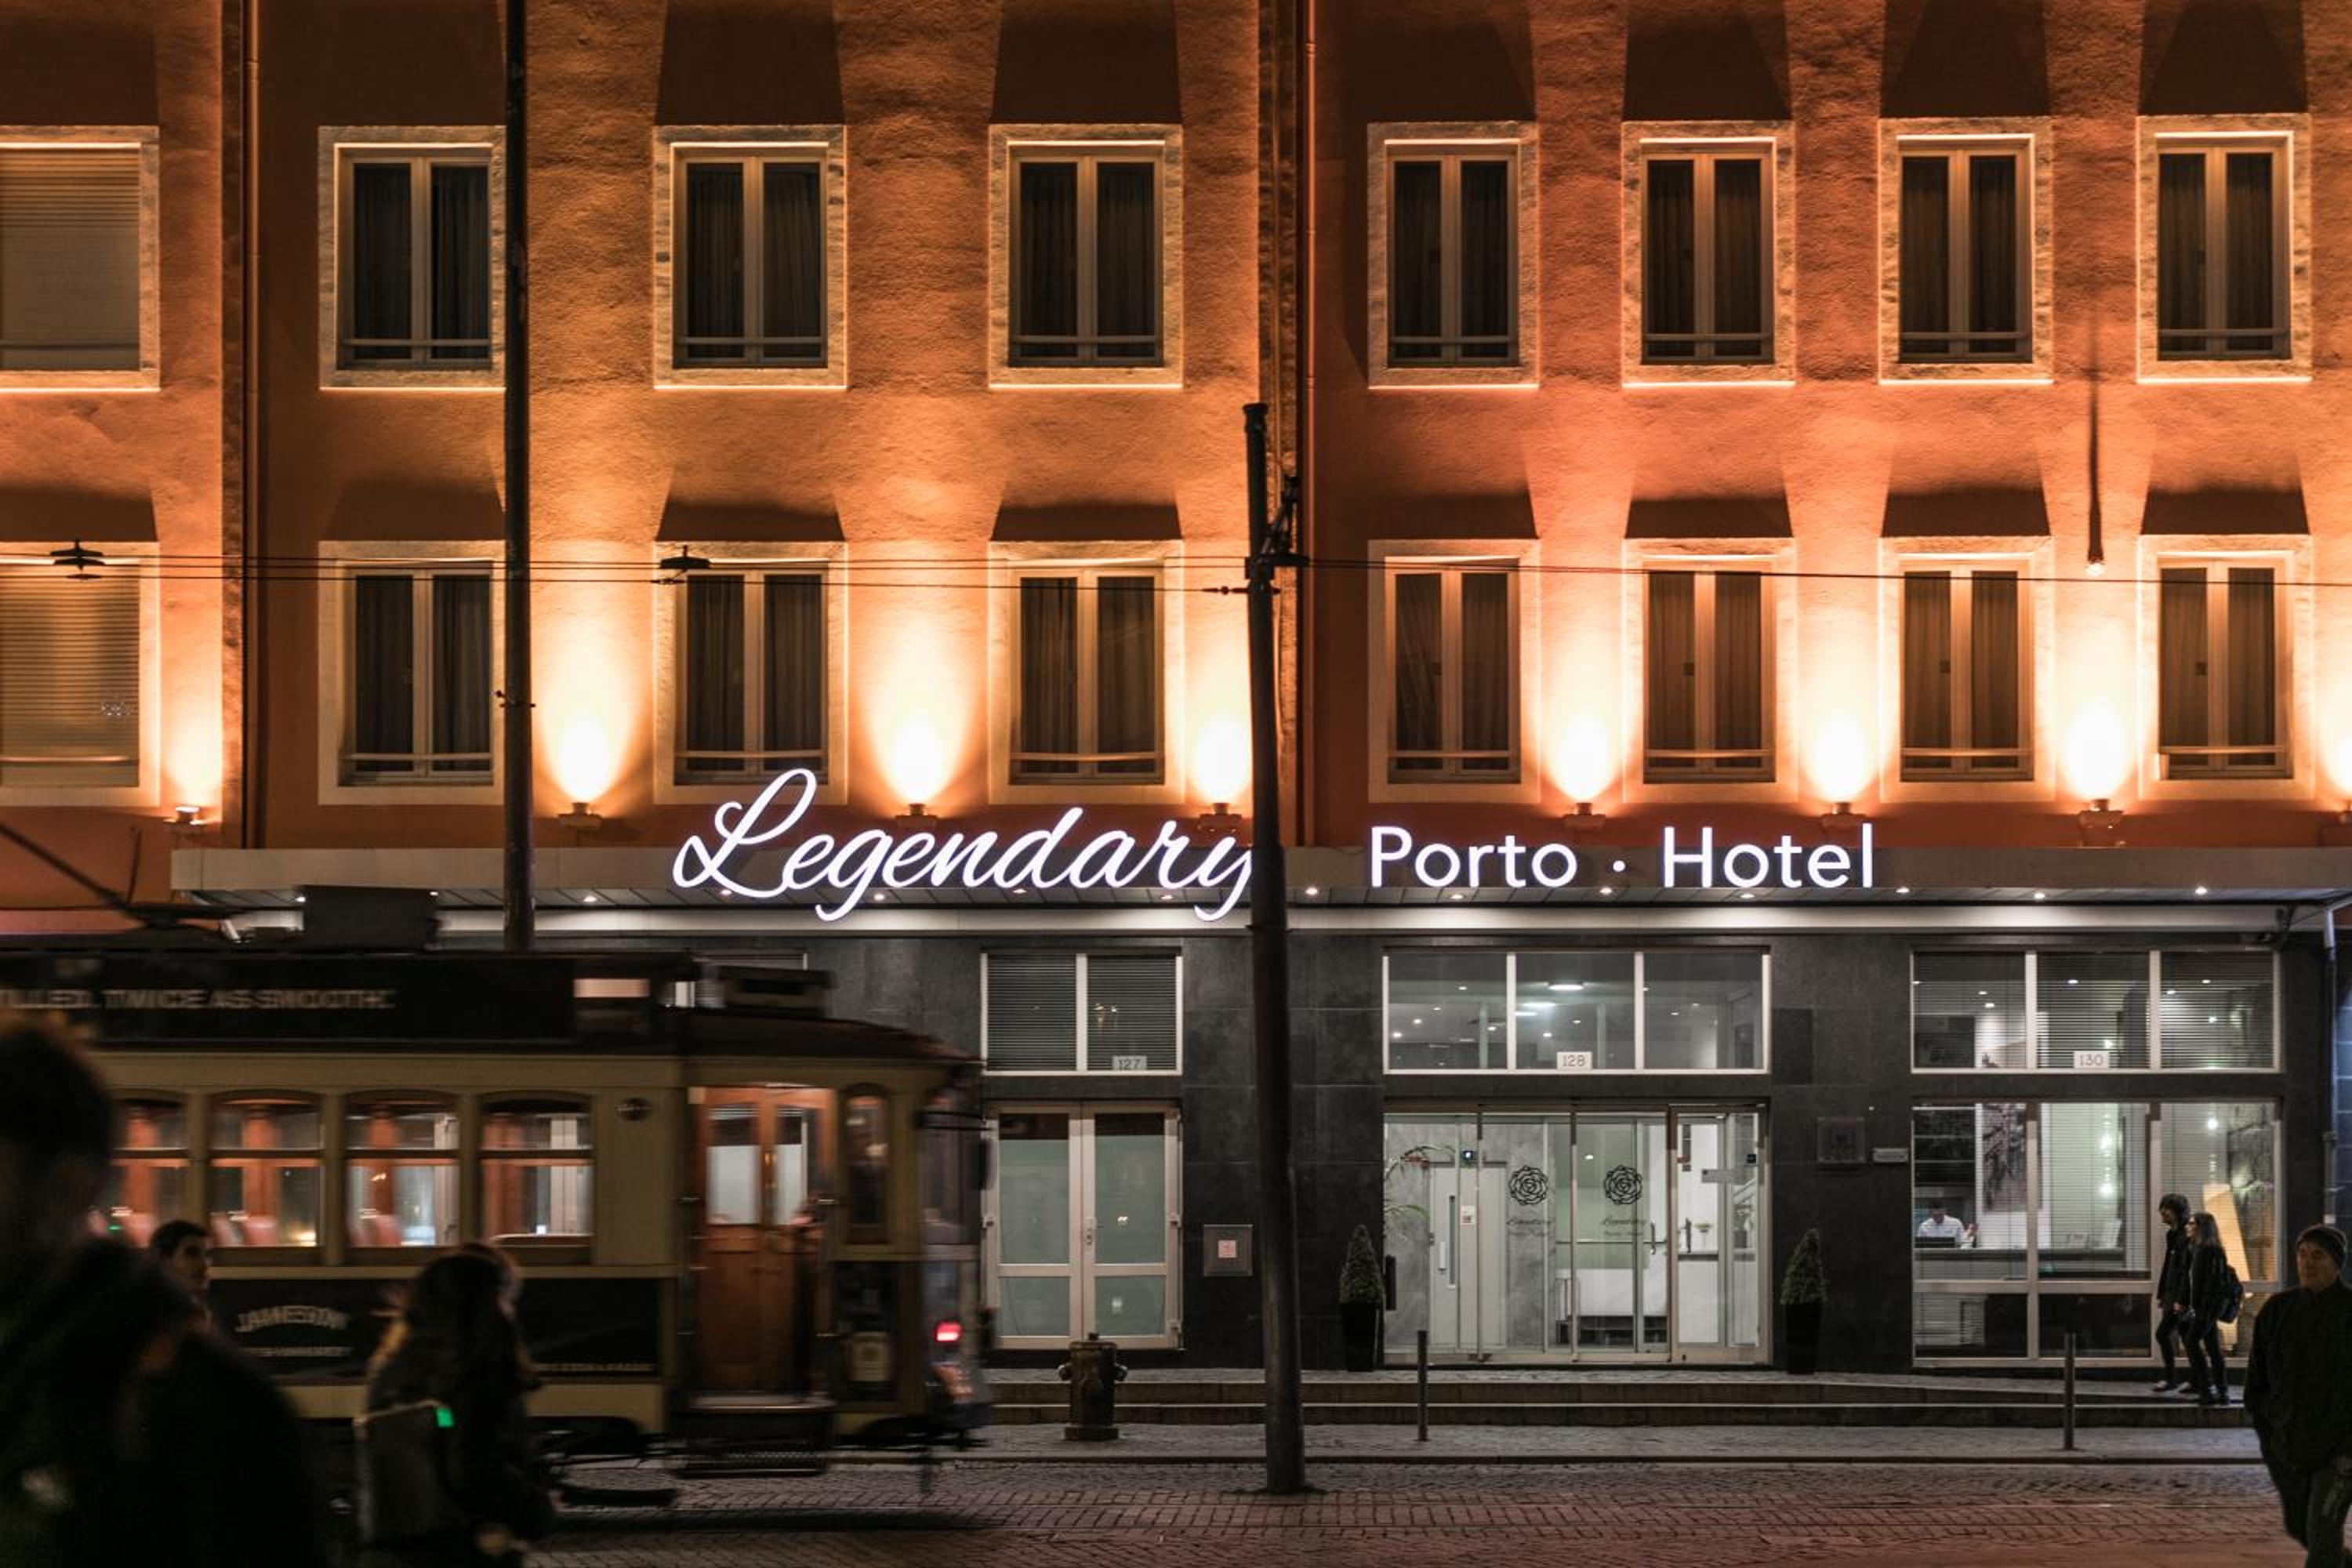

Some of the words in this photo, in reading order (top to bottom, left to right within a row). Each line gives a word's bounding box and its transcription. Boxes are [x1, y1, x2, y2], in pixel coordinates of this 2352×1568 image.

[672, 767, 1253, 922] Legendary
[1370, 826, 1578, 888] Porto
[1664, 822, 1874, 888] Hotel
[1118, 1058, 1142, 1071] 127
[1562, 1054, 1586, 1067] 128
[2079, 1054, 2104, 1066] 130
